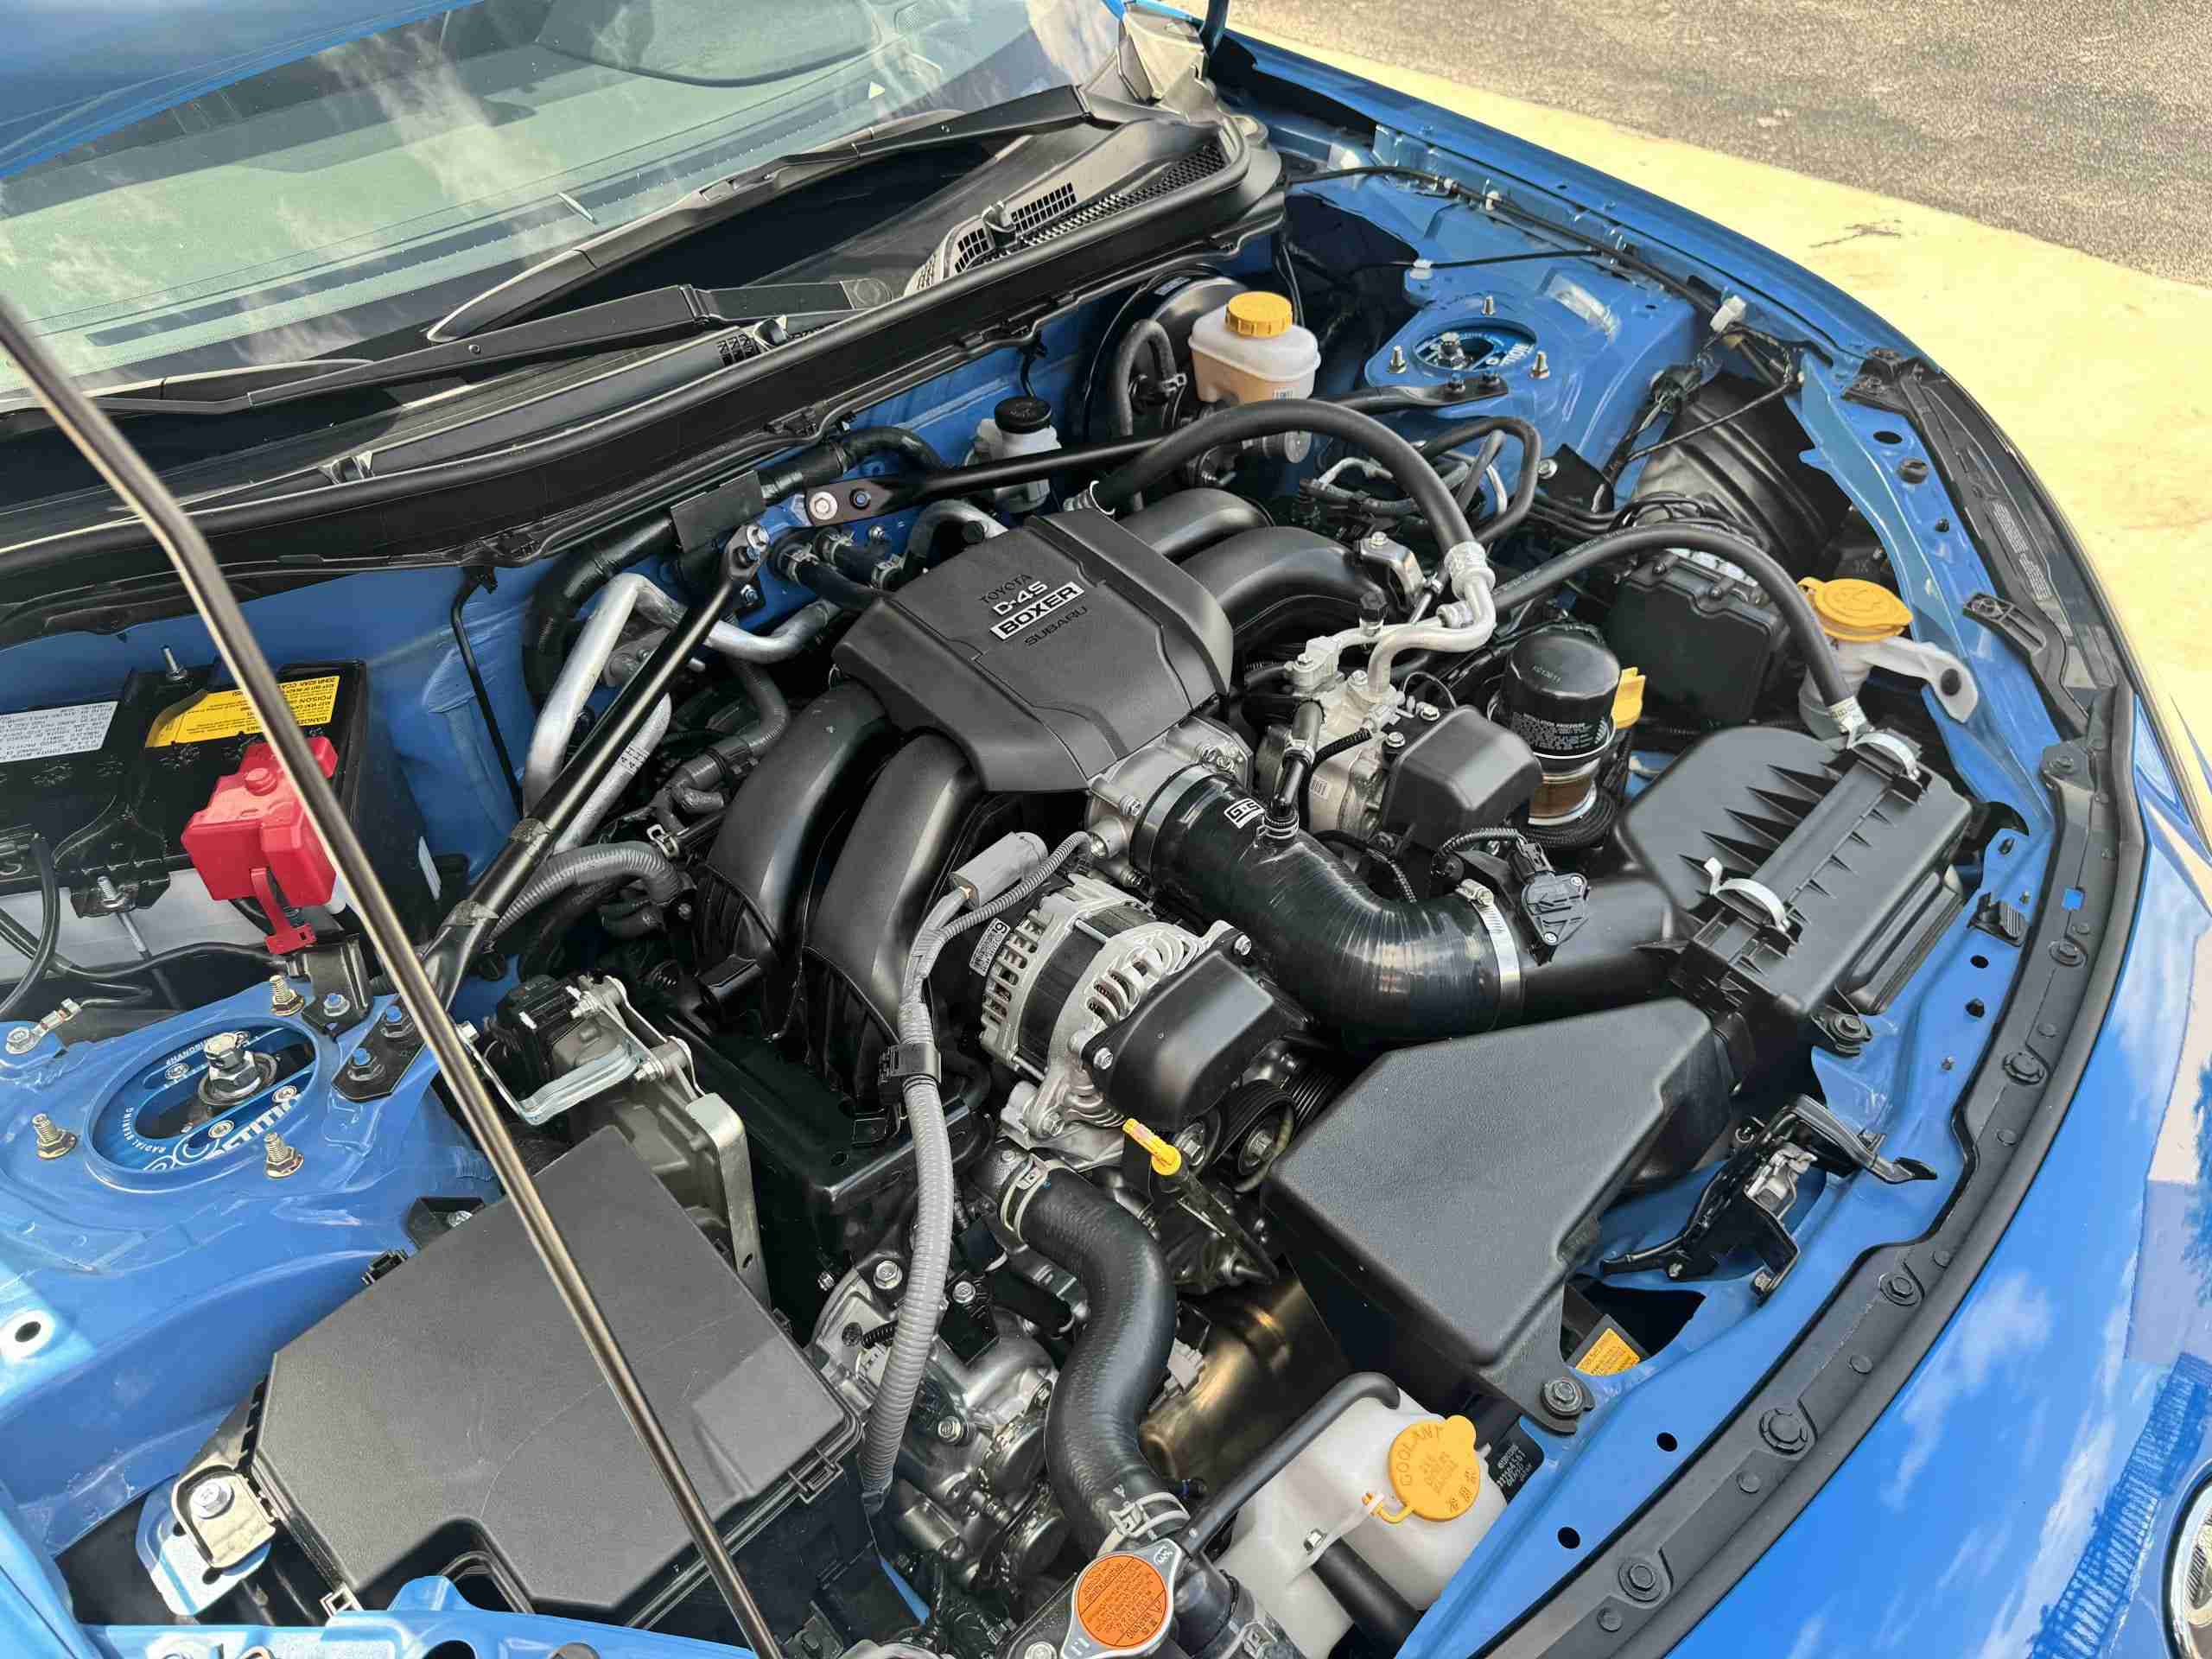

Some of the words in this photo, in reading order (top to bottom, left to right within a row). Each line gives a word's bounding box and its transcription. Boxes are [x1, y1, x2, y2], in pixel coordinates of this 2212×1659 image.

[977, 574, 1033, 603] TOYOTA
[992, 581, 1048, 616] D-4S
[997, 587, 1078, 636] BOXER
[1025, 606, 1089, 646] SUBARU
[296, 715, 327, 725] DANGE
[122, 1106, 134, 1141] BEARING
[131, 1139, 167, 1154] RADIAL
[1395, 1425, 1444, 1486] COOLANT
